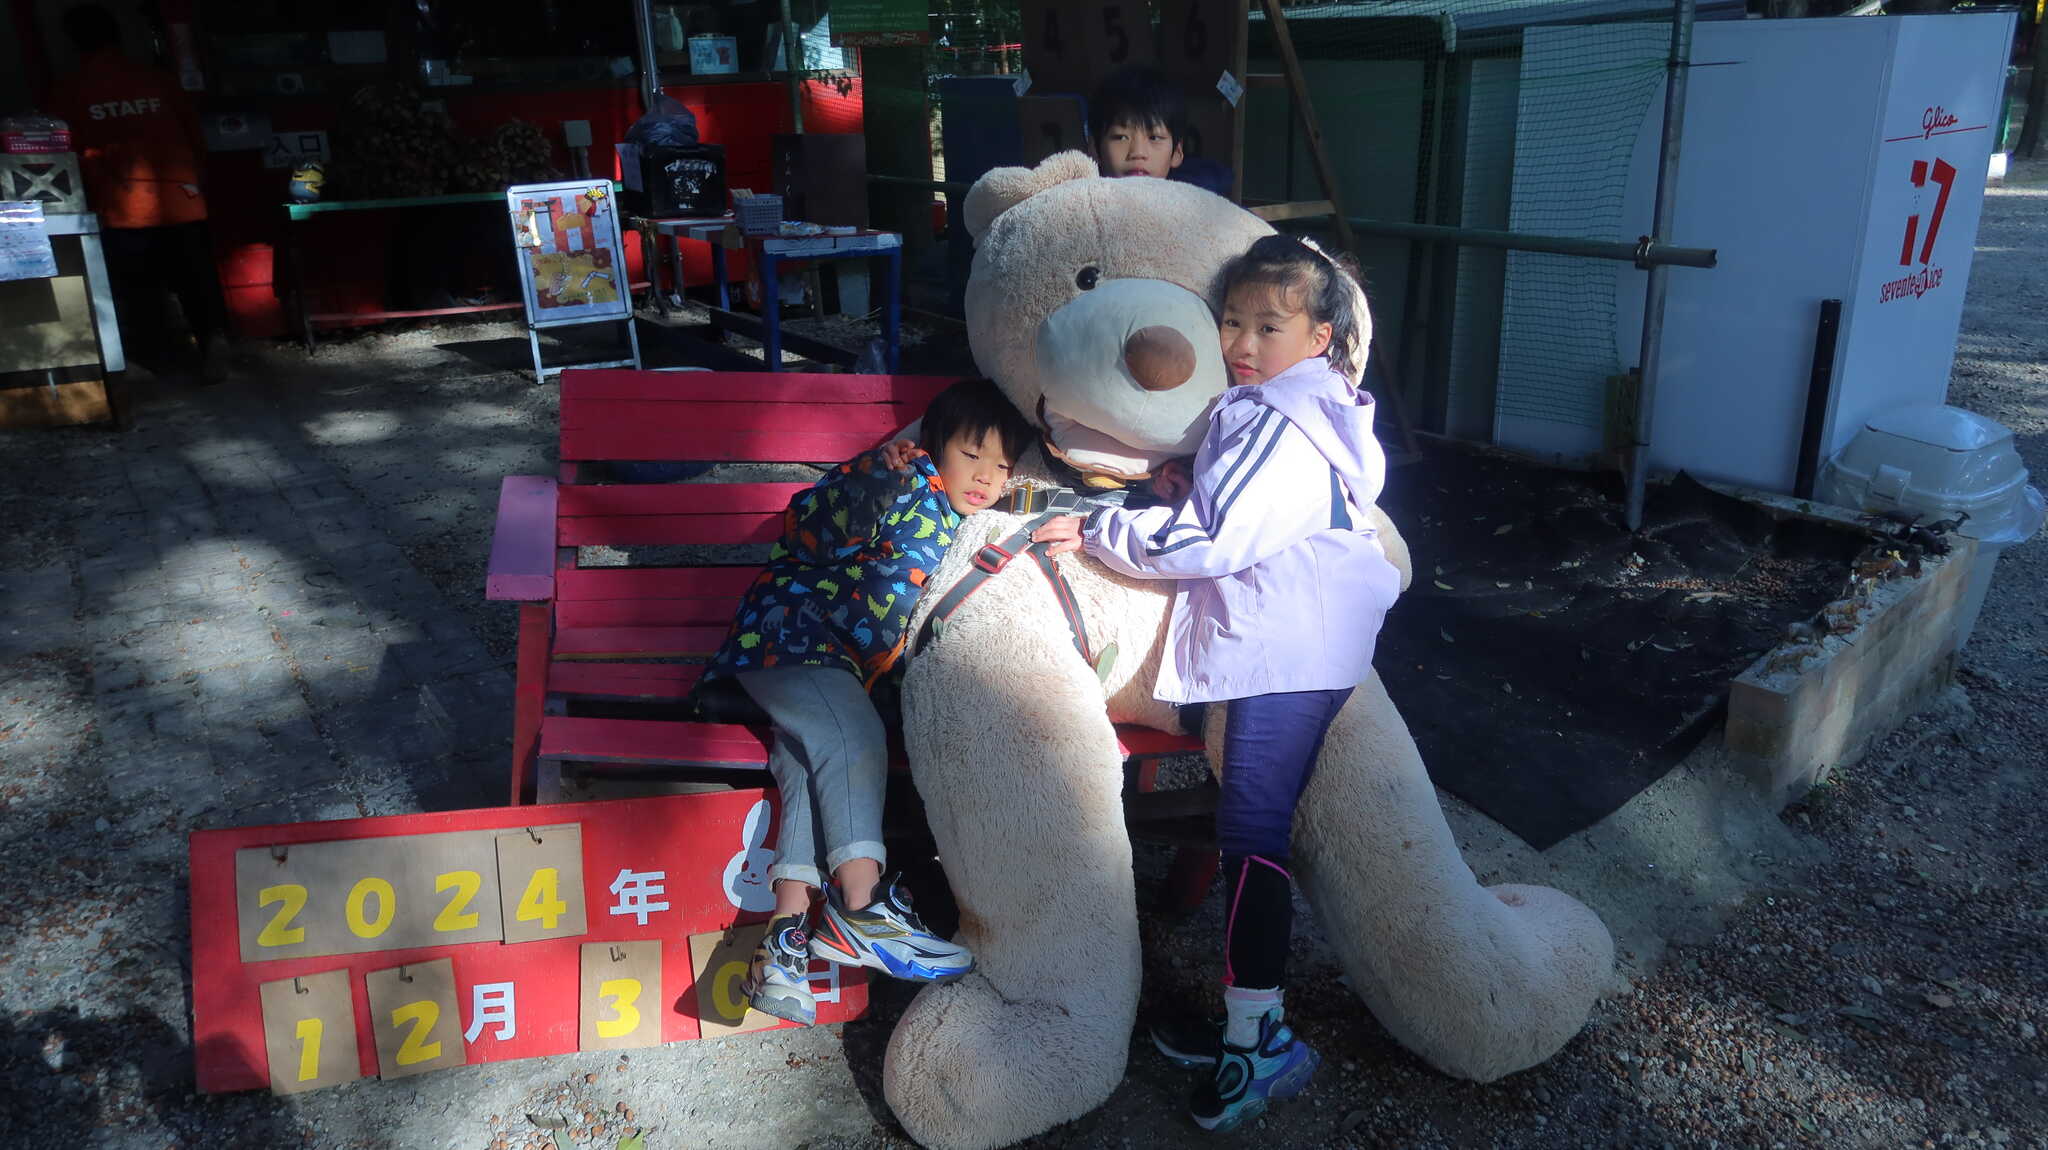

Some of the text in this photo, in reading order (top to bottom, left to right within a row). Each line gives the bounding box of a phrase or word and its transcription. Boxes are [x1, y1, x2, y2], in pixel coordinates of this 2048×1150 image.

[1043, 1, 1206, 62] 4 5 6
[88, 96, 160, 121] STAFF
[1922, 106, 1958, 140] Glico
[271, 135, 321, 154] 入口
[464, 981, 516, 1044] 月
